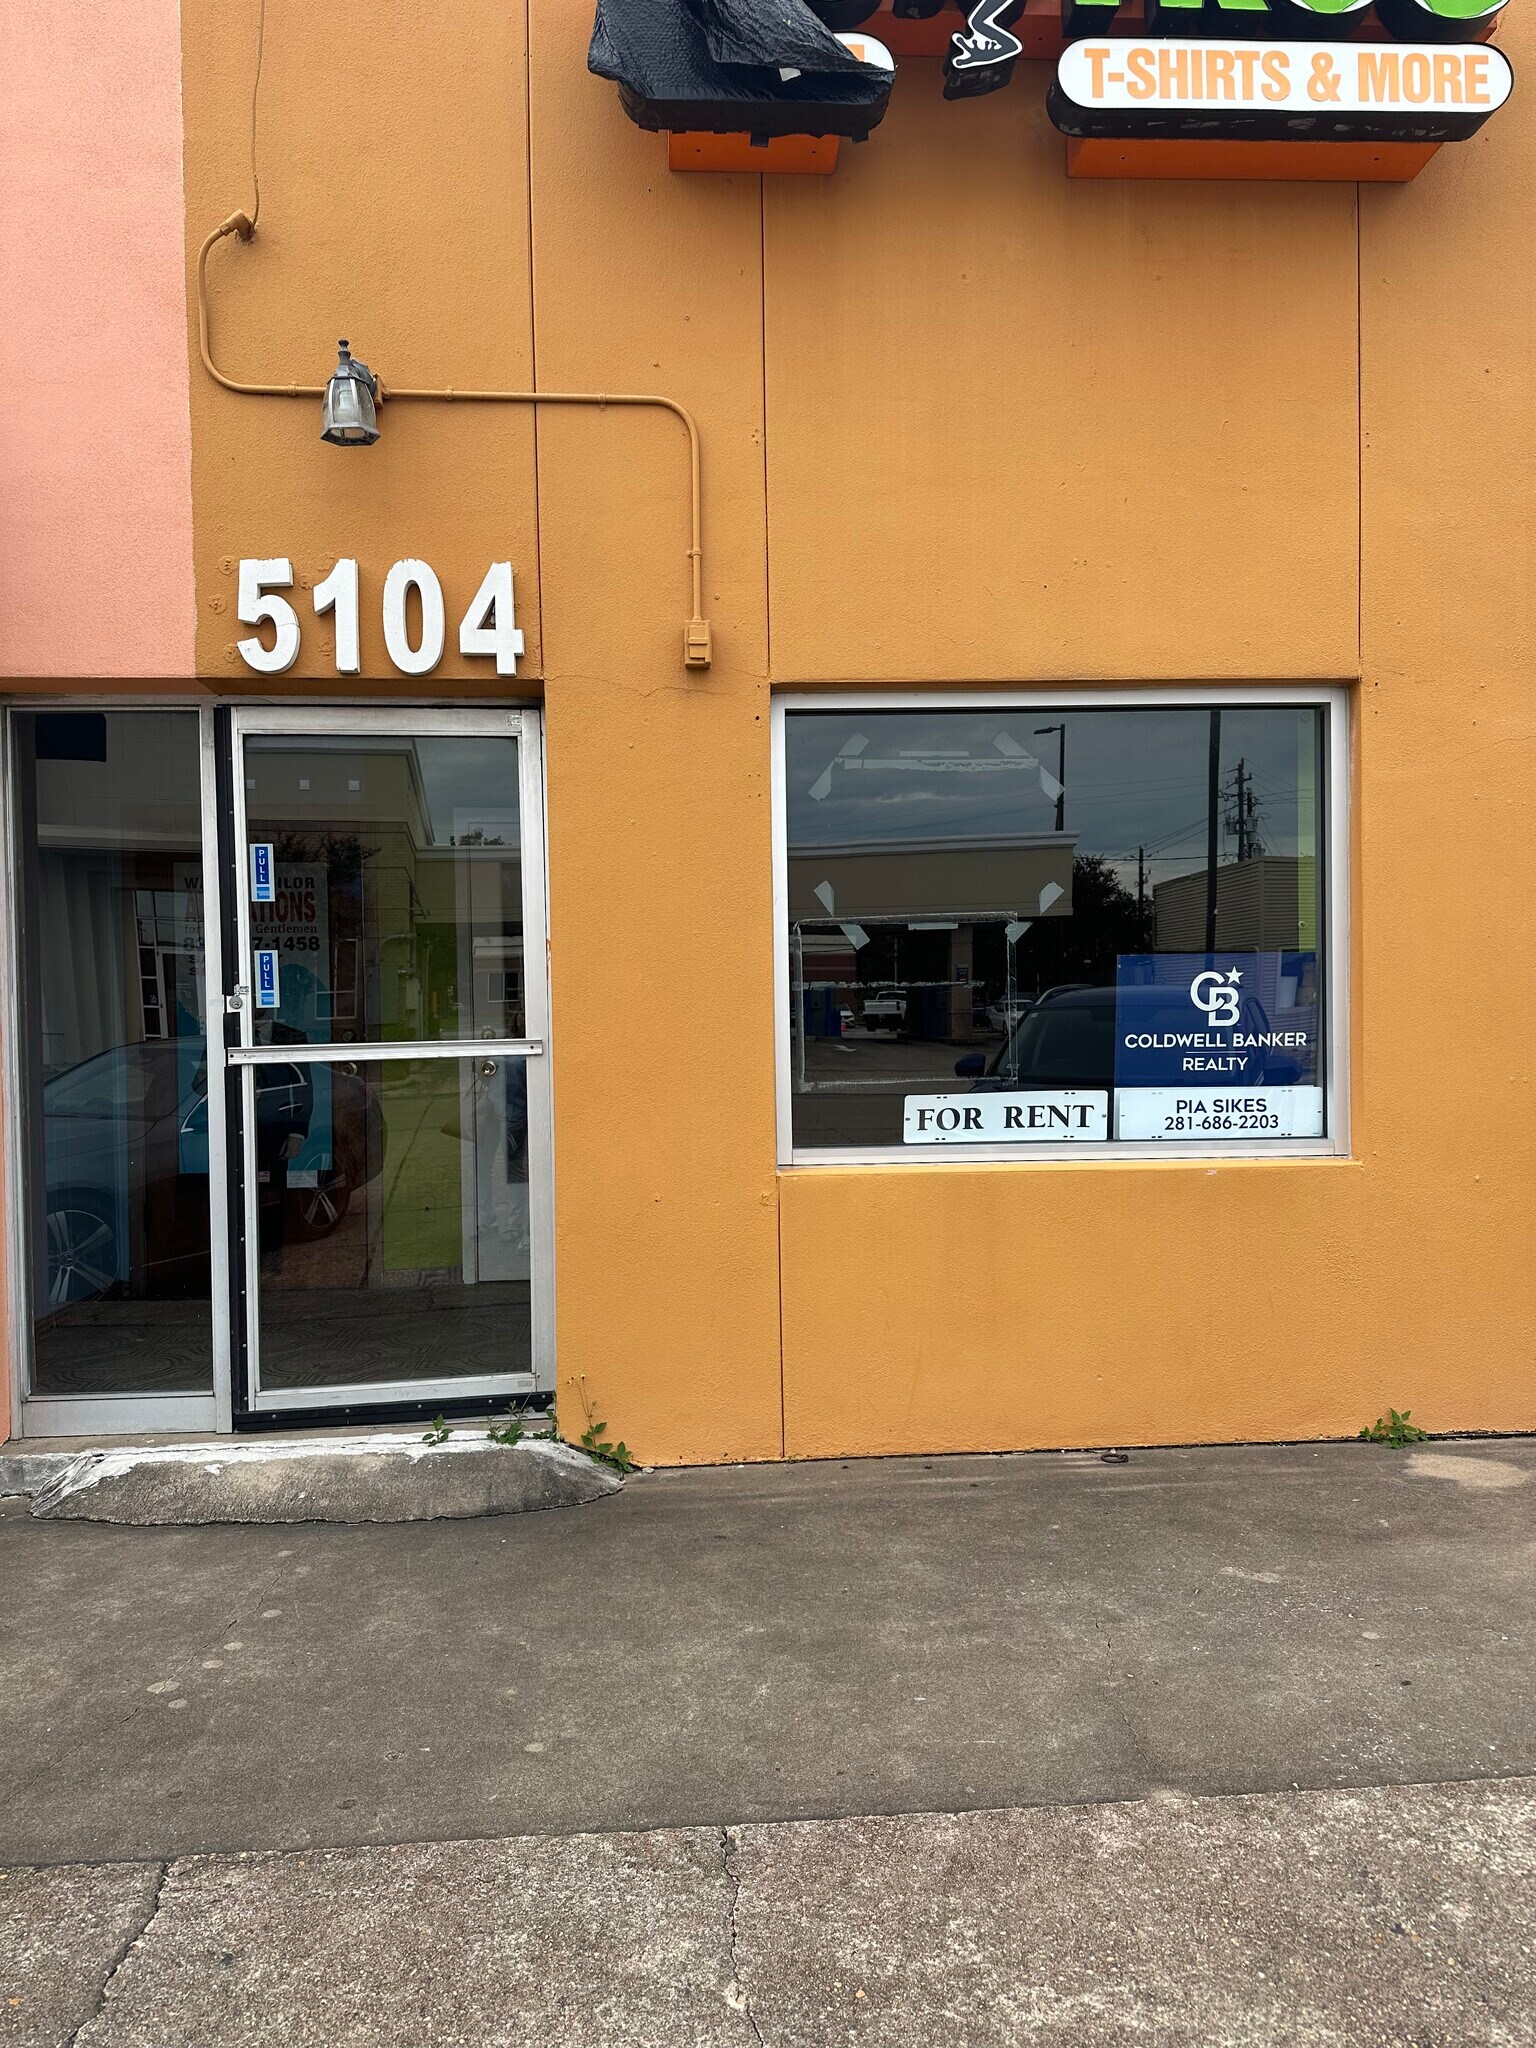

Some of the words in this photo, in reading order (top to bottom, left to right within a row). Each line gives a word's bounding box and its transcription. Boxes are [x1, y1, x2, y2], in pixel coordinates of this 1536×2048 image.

[1084, 47, 1292, 101] T-SHIRTS
[1307, 51, 1342, 102] &
[1357, 51, 1491, 104] MORE
[236, 557, 525, 676] 5104
[258, 849, 266, 882] PULL
[255, 924, 318, 934] Gentlemen
[263, 955, 271, 988] PULL
[1124, 1033, 1227, 1049] COLDWELL
[1232, 1031, 1308, 1048] BANKER
[1182, 1056, 1248, 1071] REALTY
[1176, 1099, 1209, 1114] PIA
[1212, 1097, 1267, 1114] SIKES
[916, 1106, 984, 1131] FOR
[1003, 1104, 1095, 1129] RENT
[1164, 1114, 1279, 1131] 281-686-2203
